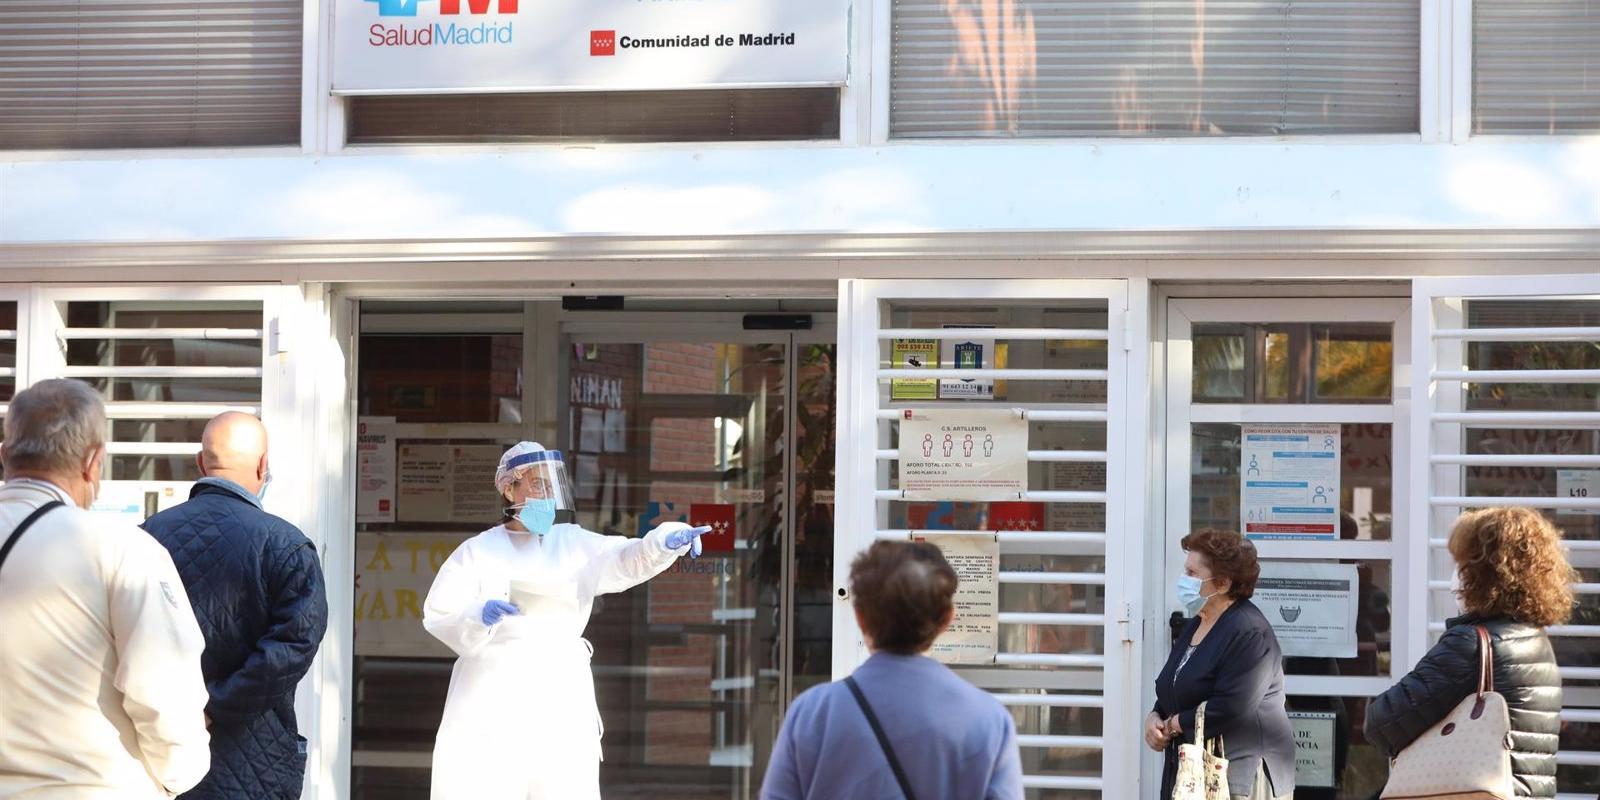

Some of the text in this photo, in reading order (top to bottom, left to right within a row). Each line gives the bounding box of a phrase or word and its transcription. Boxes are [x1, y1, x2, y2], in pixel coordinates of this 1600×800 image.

[369, 21, 513, 47] SaludMadrid
[619, 32, 796, 49] Comunidad de Madrid
[1569, 488, 1588, 498] L10
[1299, 730, 1312, 739] DE
